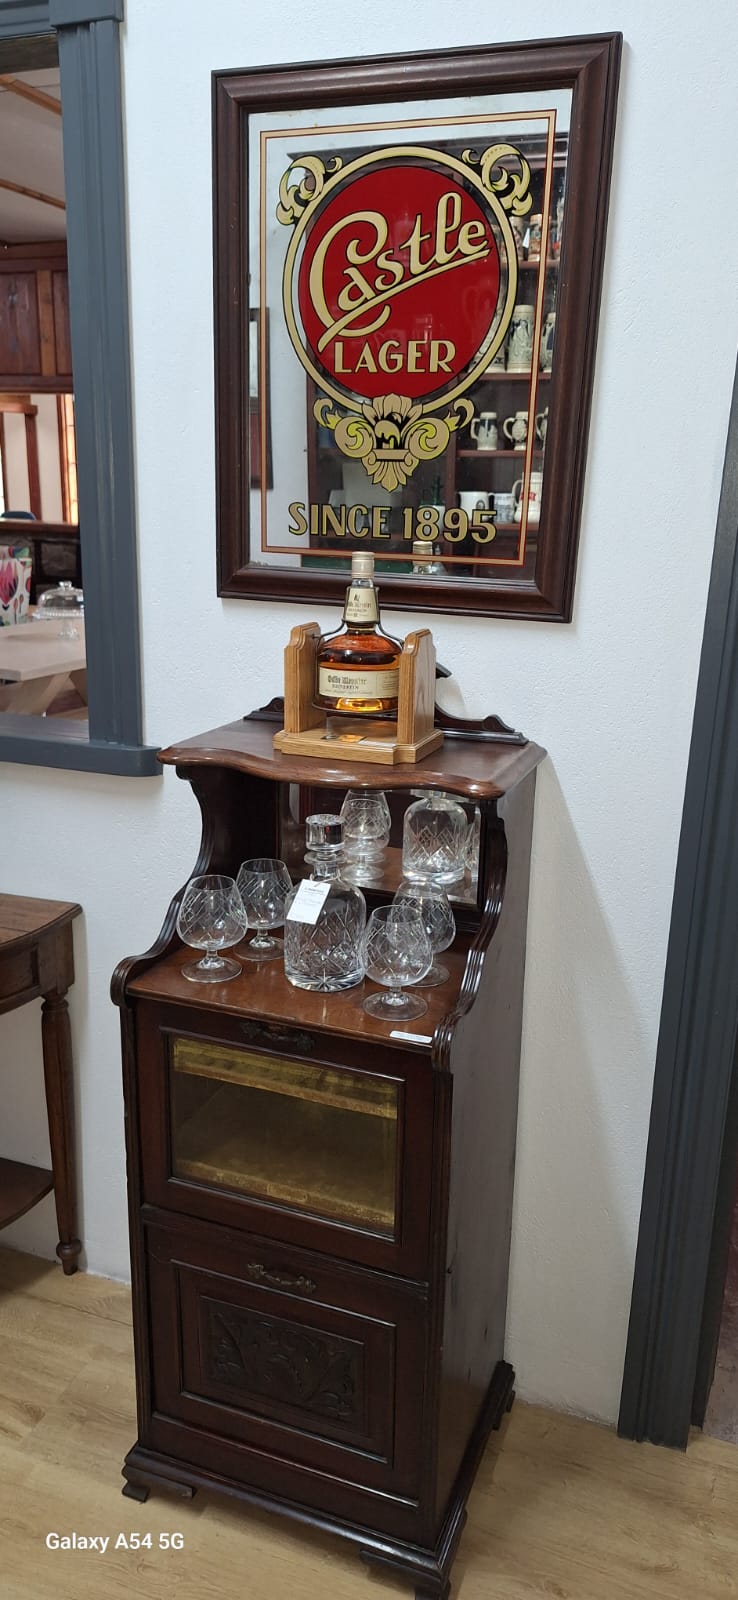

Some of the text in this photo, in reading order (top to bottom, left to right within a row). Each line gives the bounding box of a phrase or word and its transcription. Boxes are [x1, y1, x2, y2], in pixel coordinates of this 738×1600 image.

[309, 192, 491, 353] Castle
[333, 339, 456, 374] LAGER
[288, 502, 392, 539] SINCE
[402, 505, 498, 544] 1895
